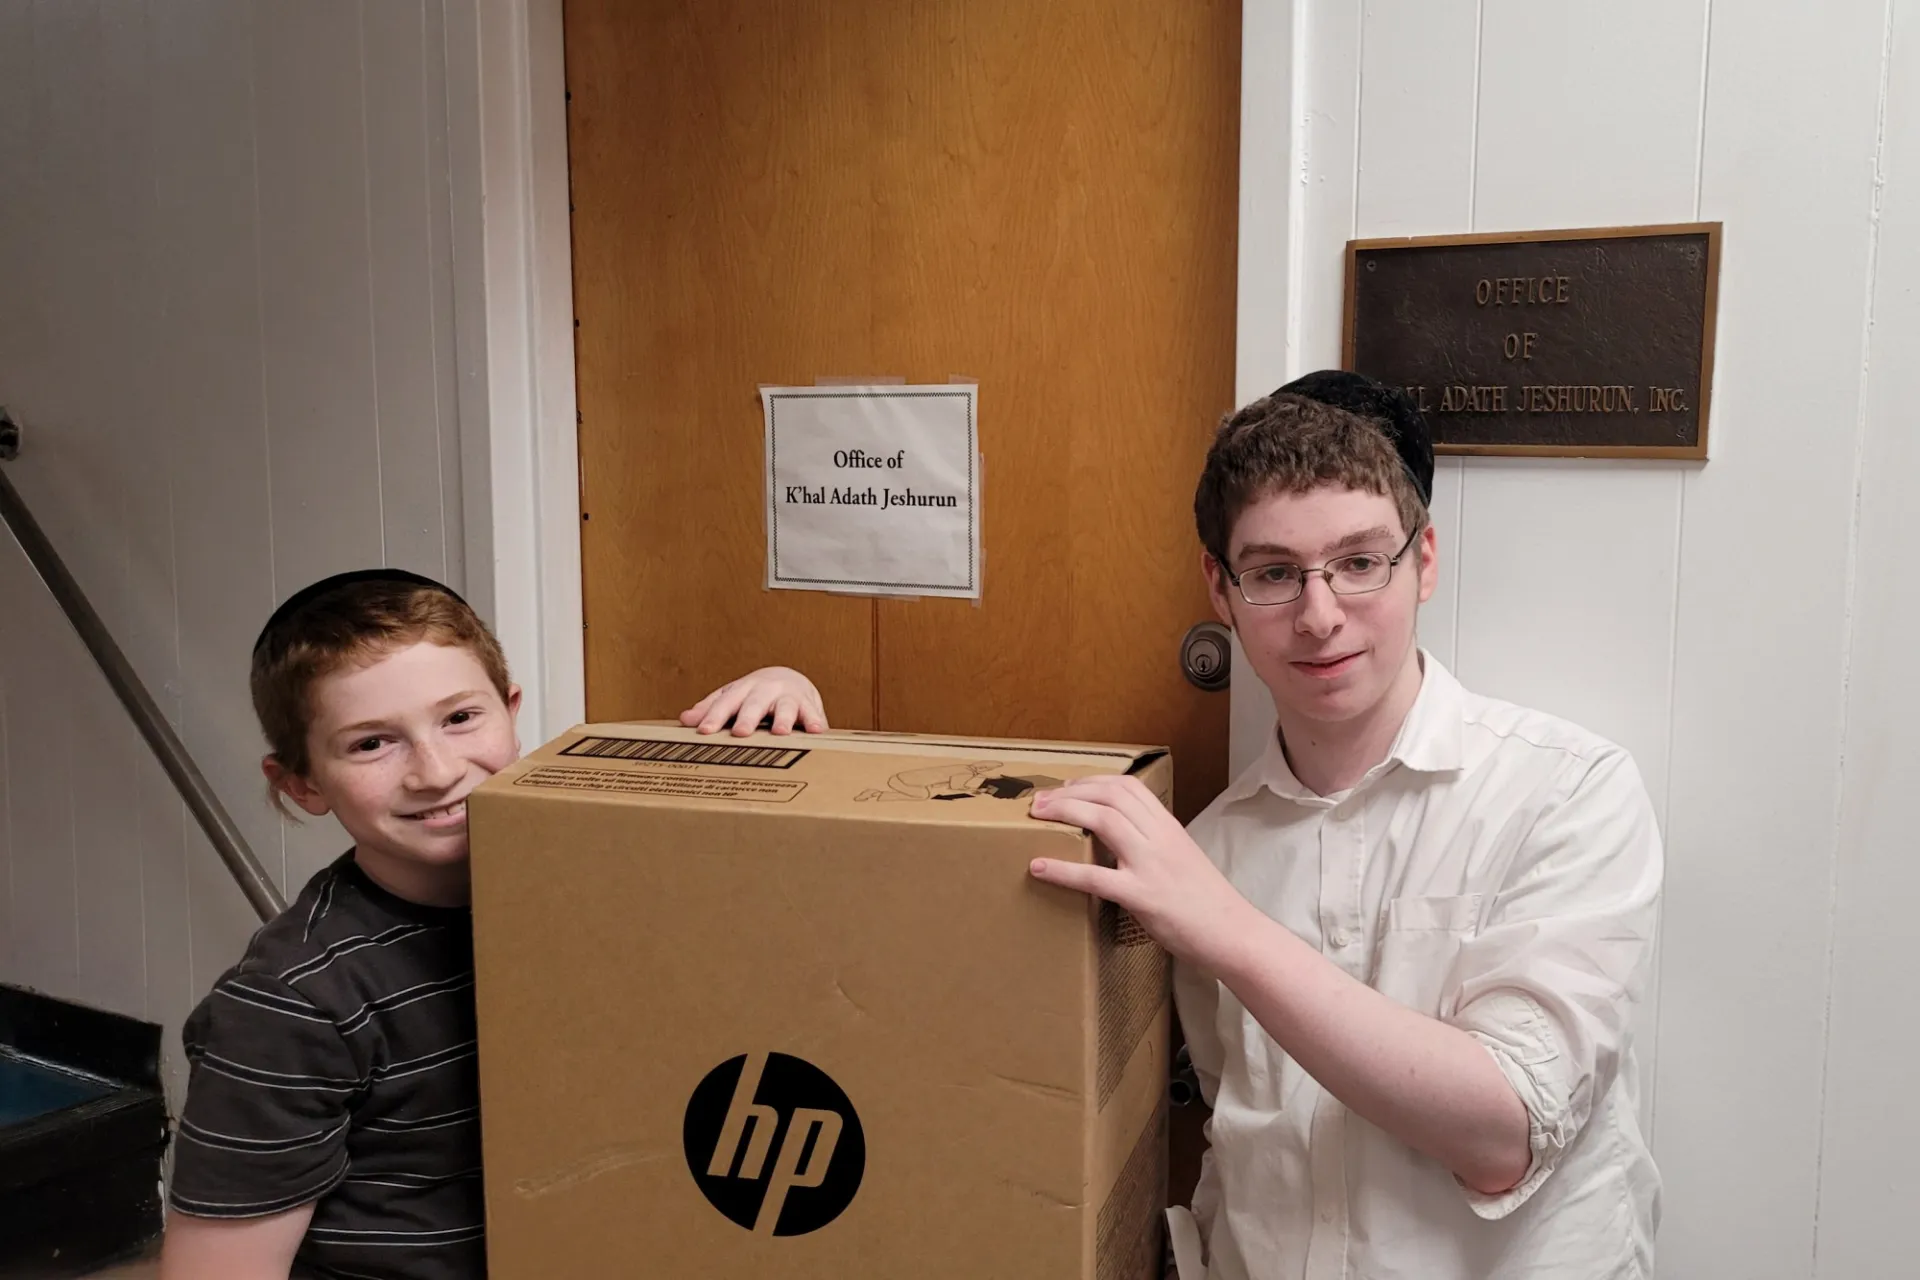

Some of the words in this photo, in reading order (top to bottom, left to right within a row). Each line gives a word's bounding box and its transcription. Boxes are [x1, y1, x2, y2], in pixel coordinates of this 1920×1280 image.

[1475, 275, 1571, 306] OFFICE
[1504, 332, 1538, 360] OF
[1439, 385, 1508, 413] ADATH
[1649, 386, 1690, 413] INC.
[833, 449, 883, 469] Office
[886, 449, 905, 469] of
[785, 486, 826, 504] K'hal
[829, 487, 878, 506] Adath
[880, 487, 958, 511] Jeshurun
[582, 781, 604, 789] chip
[662, 775, 705, 783] contiene
[751, 780, 798, 788] sicurezza
[706, 1052, 843, 1236] hp
